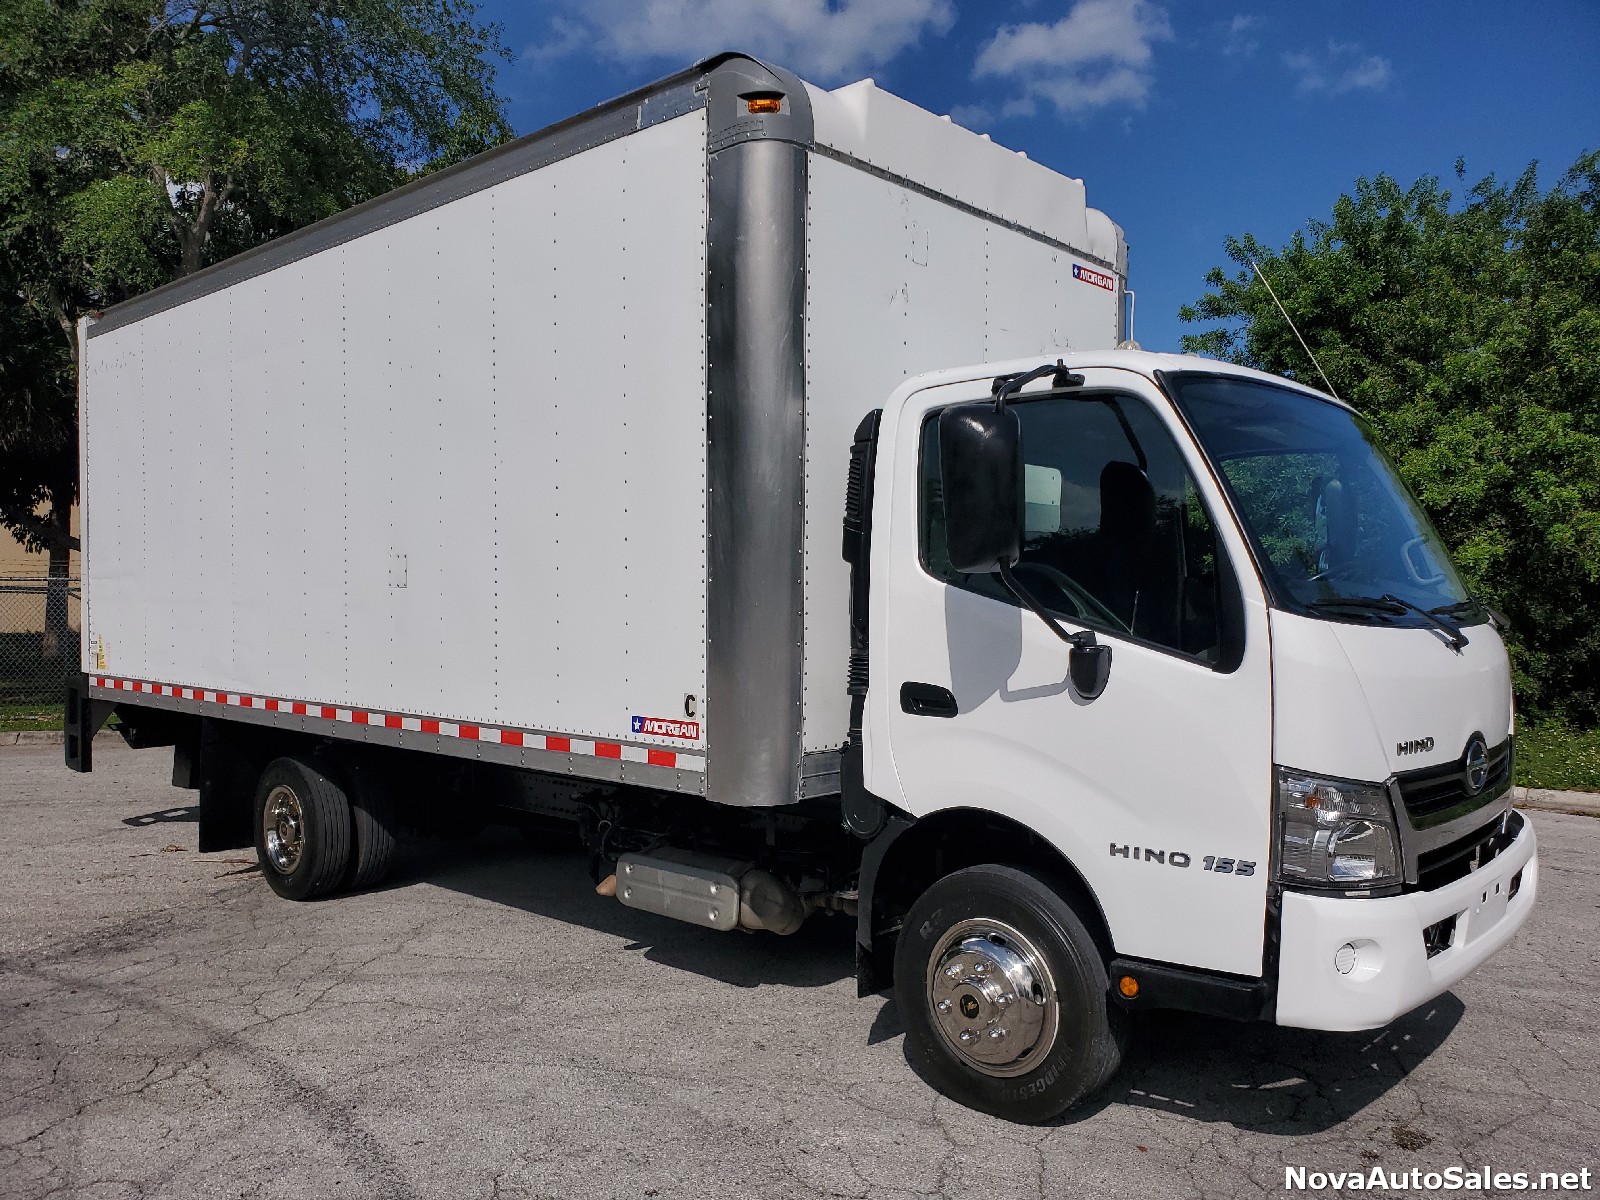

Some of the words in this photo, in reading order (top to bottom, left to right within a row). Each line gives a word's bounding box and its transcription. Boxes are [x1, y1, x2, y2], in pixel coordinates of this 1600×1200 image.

[1080, 269, 1113, 290] MORGAN
[684, 694, 696, 718] C
[643, 719, 697, 738] MORGAN
[1396, 736, 1435, 757] HINO
[1109, 842, 1192, 868] HINO
[1202, 855, 1257, 877] 155
